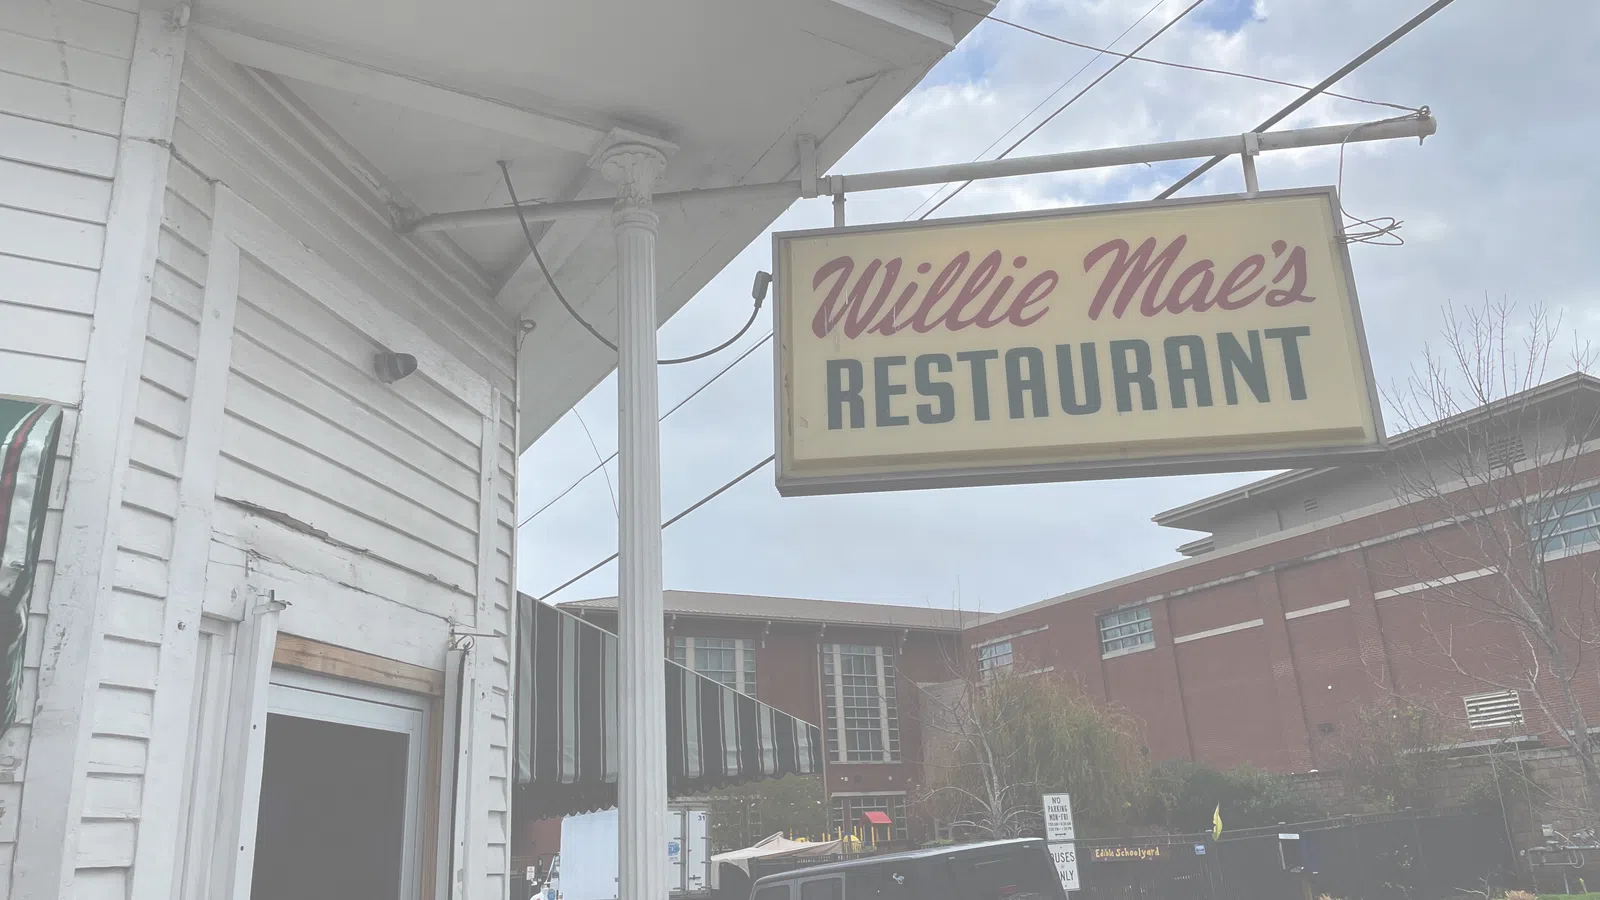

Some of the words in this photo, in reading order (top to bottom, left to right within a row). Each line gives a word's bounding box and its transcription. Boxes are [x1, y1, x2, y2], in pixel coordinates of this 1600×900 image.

[812, 249, 1059, 341] Willie
[1083, 234, 1317, 322] Mae's
[826, 325, 1311, 431] RESTAURANT
[1060, 870, 1074, 881] NLY
[1095, 848, 1115, 858] Edible
[1116, 846, 1160, 860] Schoolyard
